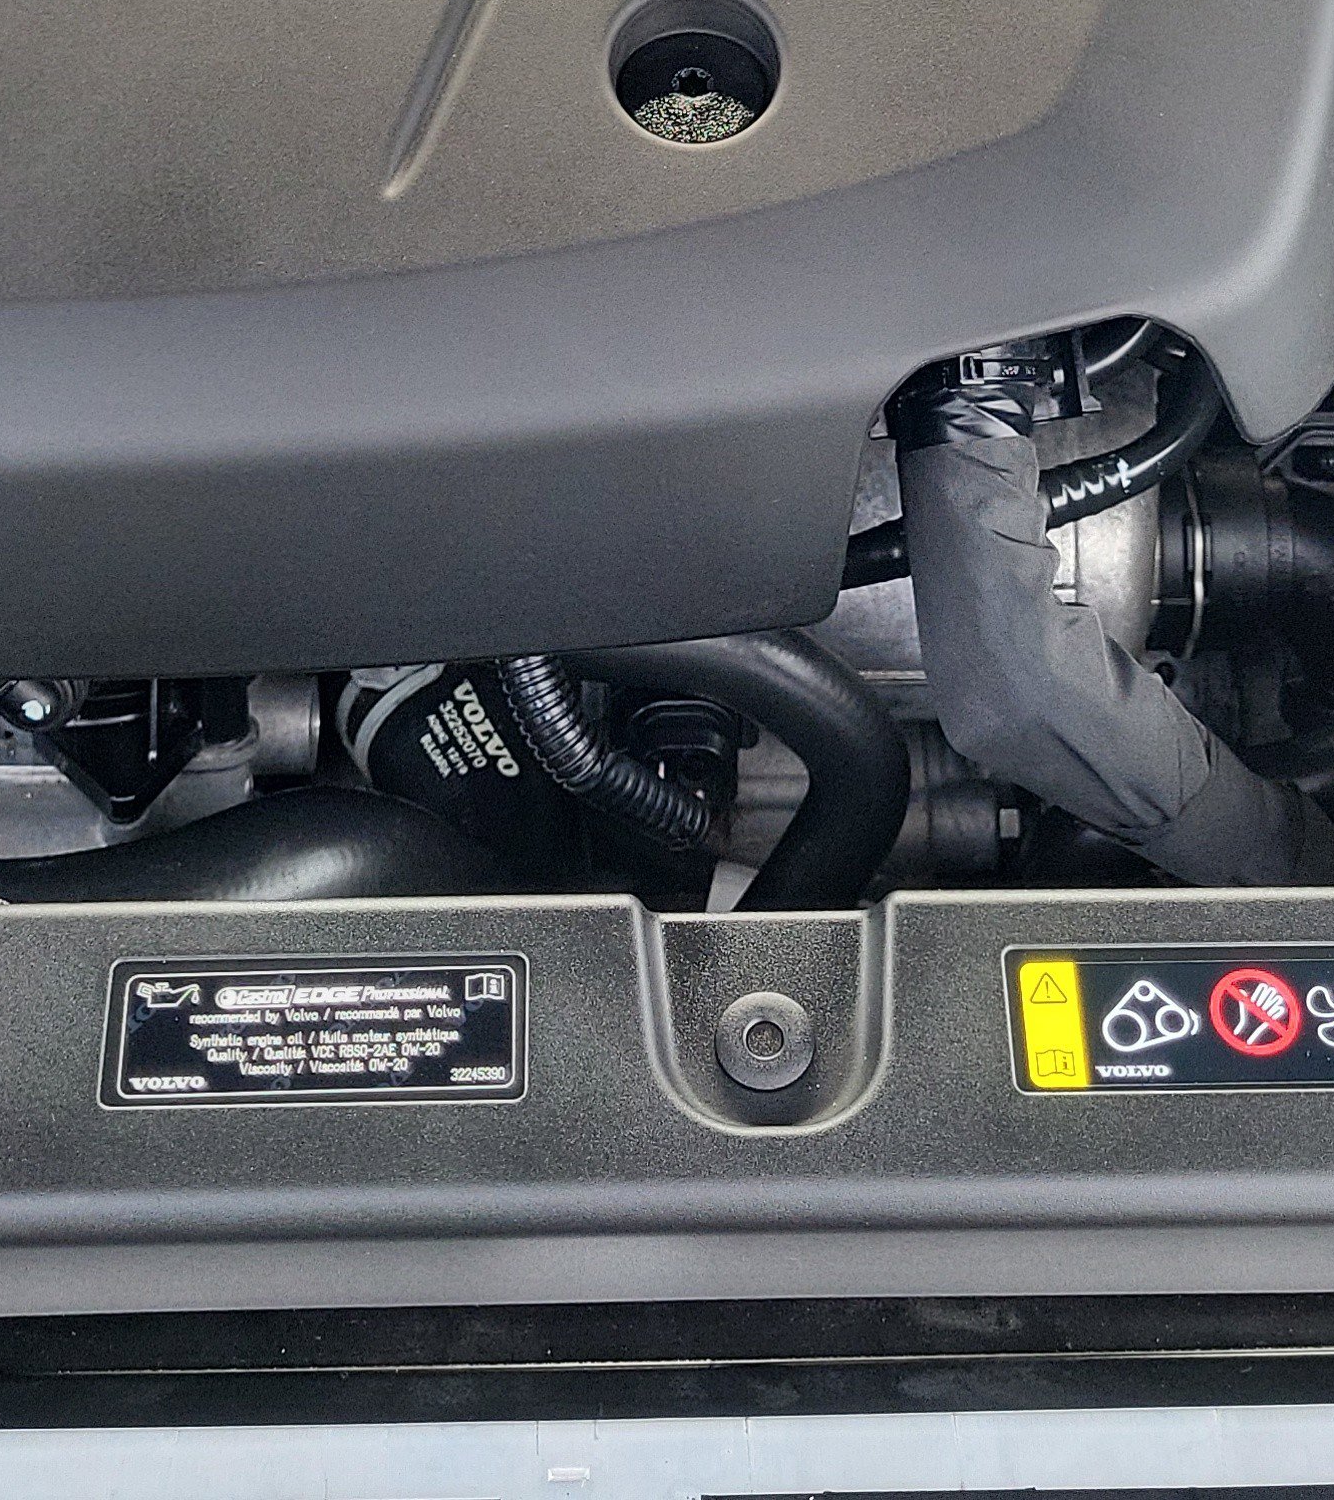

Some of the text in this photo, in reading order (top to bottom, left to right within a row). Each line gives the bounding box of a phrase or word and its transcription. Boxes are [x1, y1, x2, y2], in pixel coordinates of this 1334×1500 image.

[439, 700, 488, 770] 32252070
[452, 678, 520, 778] VOLVO
[292, 986, 363, 1004] EDGE
[188, 1011, 261, 1025] recommended
[265, 1010, 280, 1025] by
[285, 1008, 320, 1022] Volvo
[335, 1006, 400, 1021] recommandé
[404, 1008, 422, 1021] par
[427, 1004, 462, 1018] Volvo
[189, 1033, 244, 1050] Synthetic
[247, 1034, 284, 1048] engine
[287, 1031, 304, 1045] oil
[319, 1030, 349, 1044] Huile
[353, 1029, 392, 1043] moteur
[395, 1028, 460, 1044] synthétique
[207, 1048, 249, 1063] Quality
[311, 1044, 335, 1058] VCC
[239, 1062, 293, 1077] Viscosity
[1095, 1065, 1170, 1078] VOLVO
[128, 1075, 206, 1091] VOLVO
